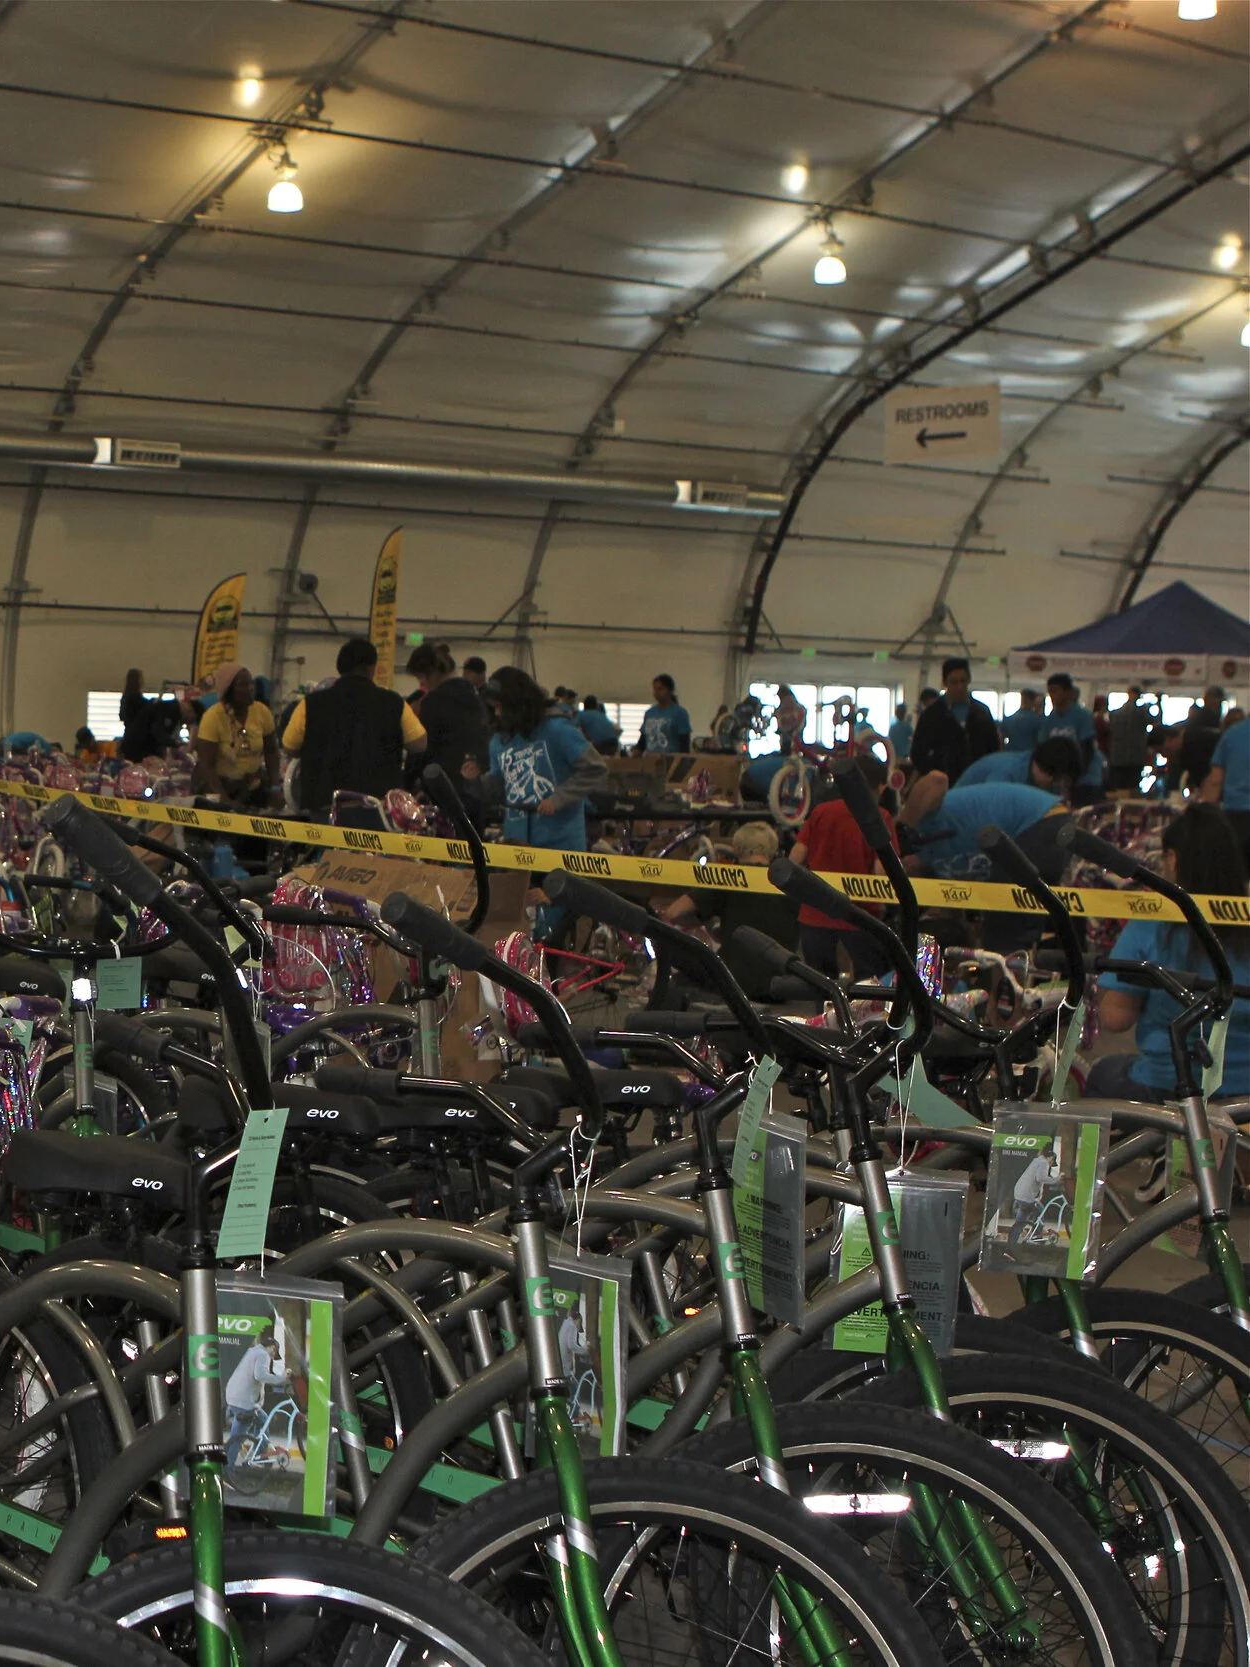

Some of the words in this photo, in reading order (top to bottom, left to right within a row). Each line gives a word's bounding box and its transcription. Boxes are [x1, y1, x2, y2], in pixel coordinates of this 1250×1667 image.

[895, 401, 989, 424] RESTROOMS
[166, 807, 199, 825] CAUTION
[250, 818, 287, 838] CAUTION
[343, 830, 383, 851] CAUTION
[446, 842, 491, 864] CTION
[329, 864, 376, 884] AVIGO
[562, 854, 611, 876] CAUTION
[693, 865, 748, 888] CAUTION
[841, 877, 894, 899] AUTION
[19, 981, 39, 990] evo
[620, 1084, 650, 1095] evo
[306, 1107, 339, 1120] evo
[444, 1107, 478, 1118] evo
[1004, 1136, 1038, 1147] evo
[132, 1176, 163, 1190] evo
